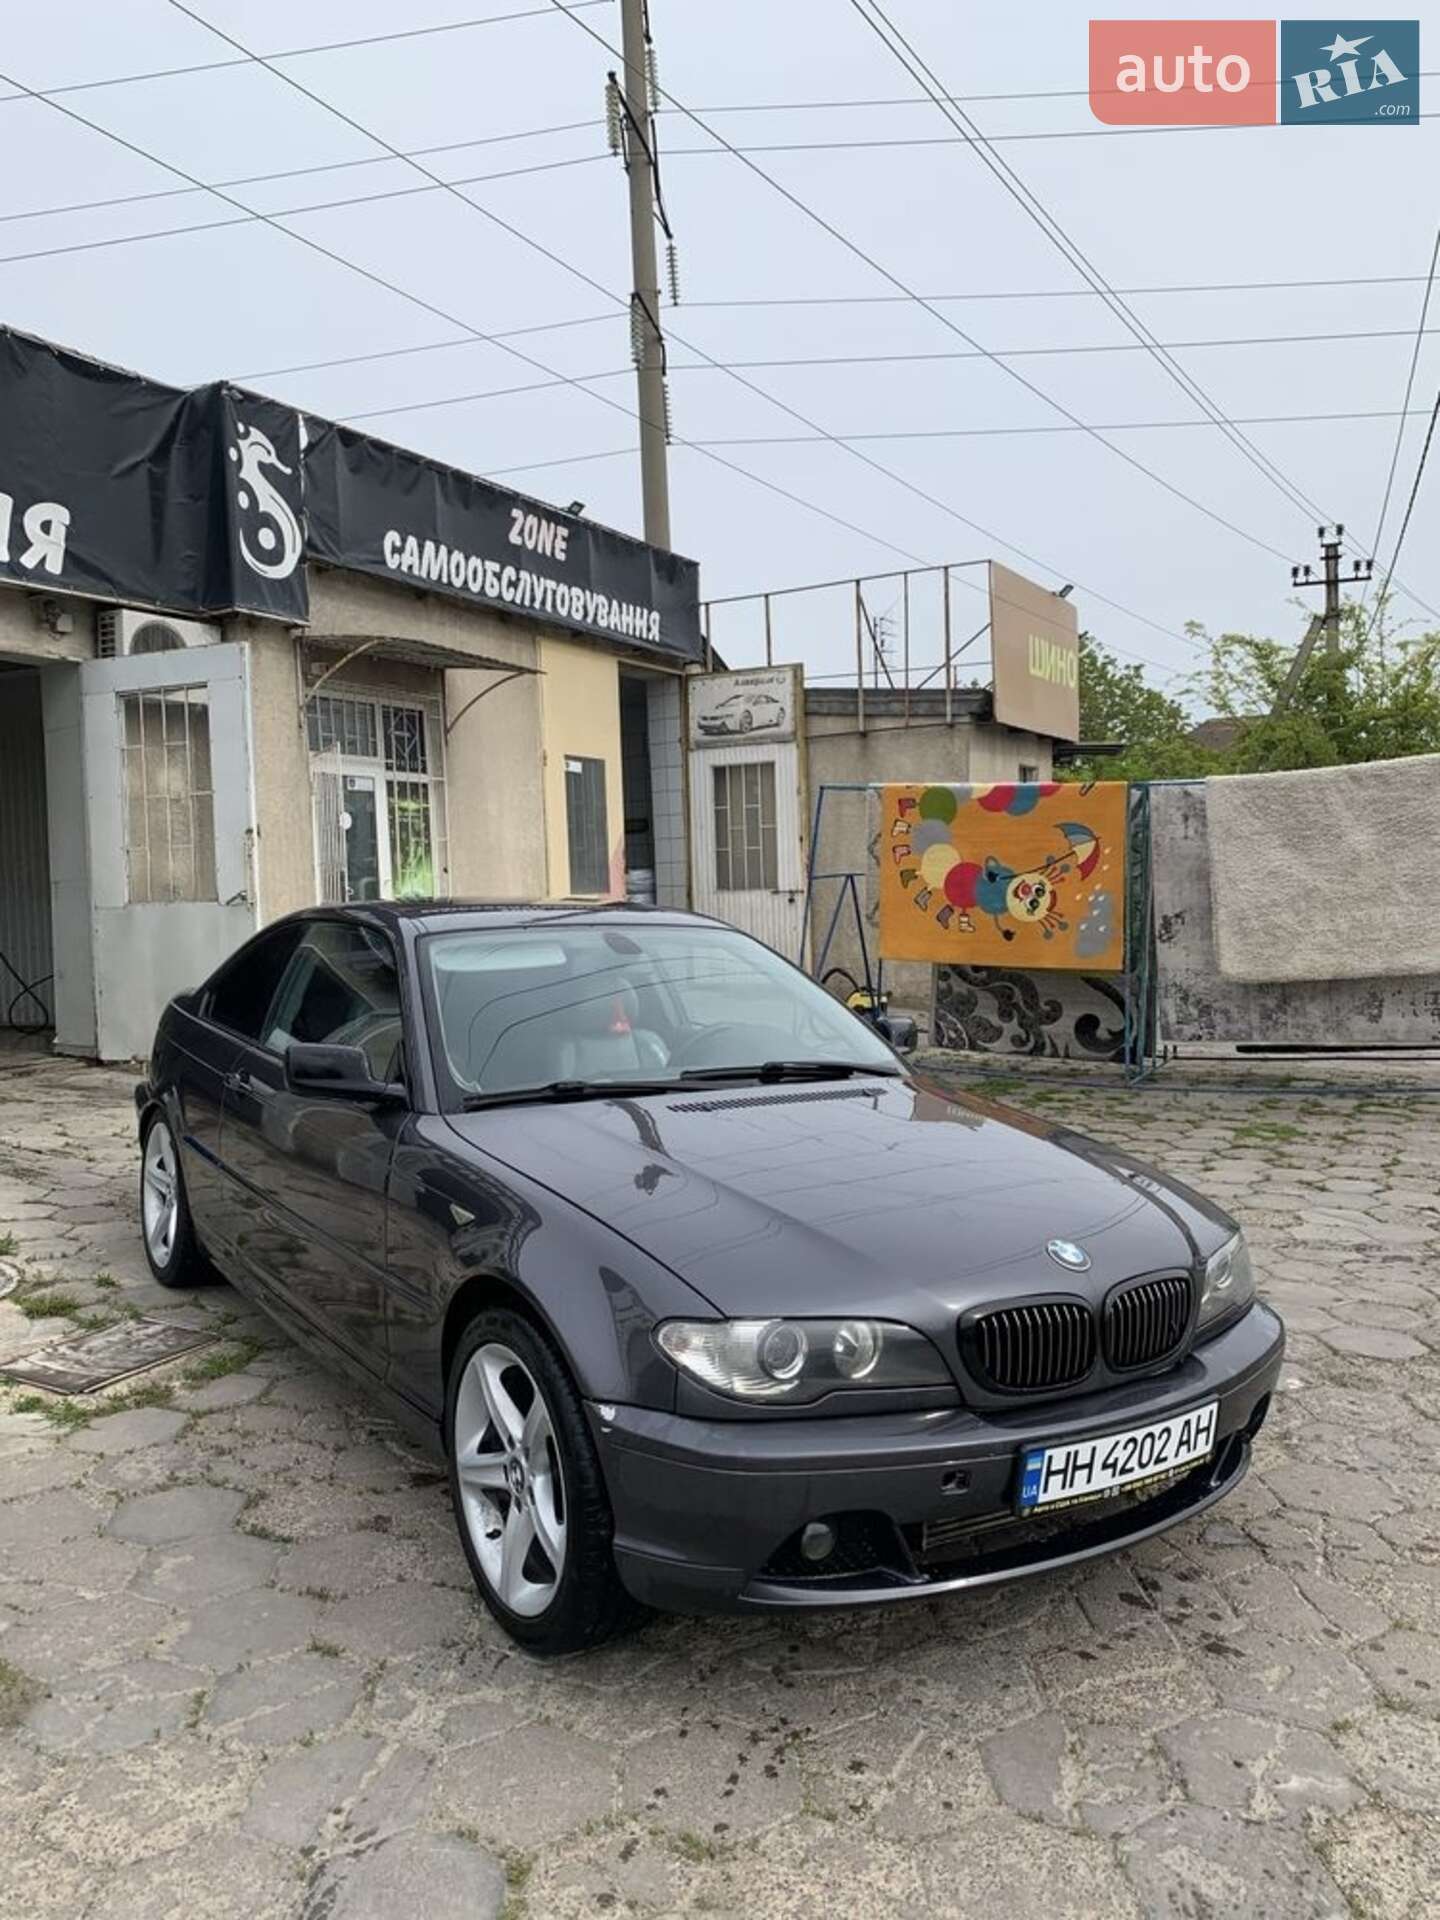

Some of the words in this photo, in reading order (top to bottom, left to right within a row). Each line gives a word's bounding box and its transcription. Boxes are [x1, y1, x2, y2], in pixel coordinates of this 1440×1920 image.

[508, 508, 569, 561] ZONE
[383, 529, 660, 642] САМООБСЛУГОВУВАННЯ
[1042, 1445, 1097, 1495] HH
[1101, 1426, 1172, 1479] 4202
[1174, 1409, 1215, 1458] AH
[1022, 1484, 1038, 1498] UA
